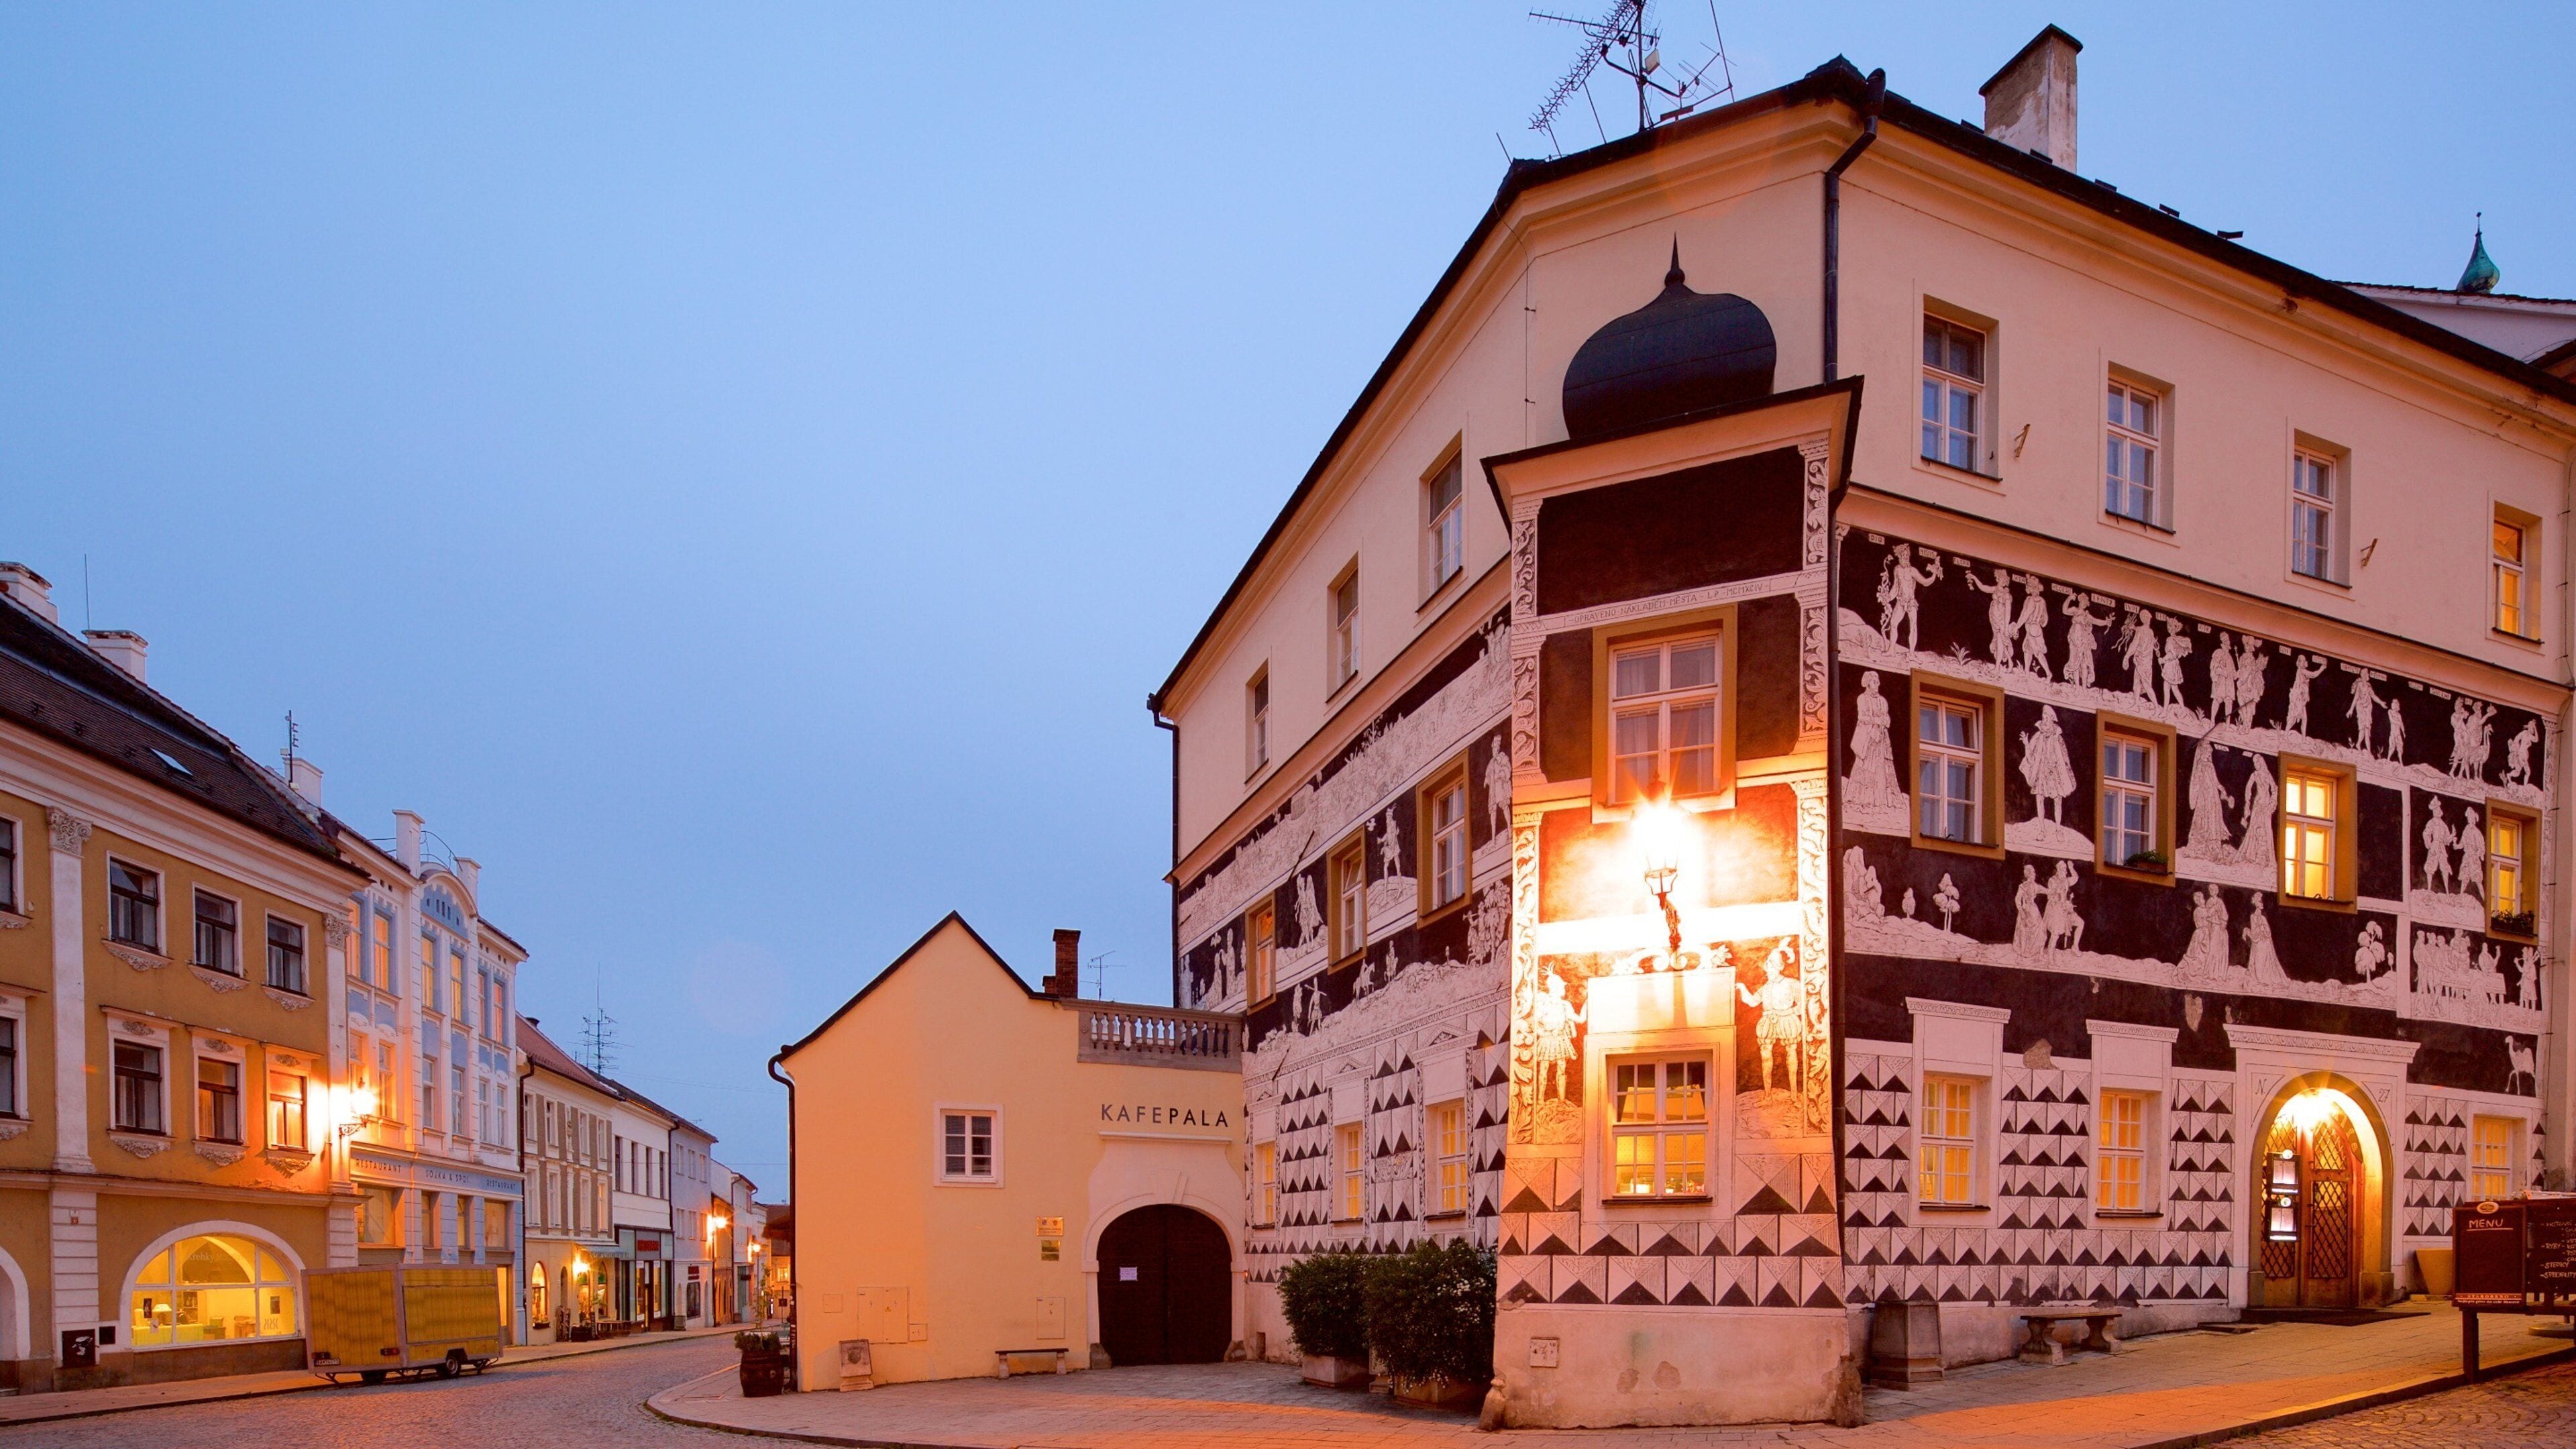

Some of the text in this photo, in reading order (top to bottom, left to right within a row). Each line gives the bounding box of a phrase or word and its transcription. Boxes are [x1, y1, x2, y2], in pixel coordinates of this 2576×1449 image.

[1574, 608, 1616, 623] OPRAVENO
[1727, 583, 1763, 596] MCMXCIV
[2378, 1088, 2391, 1104] 27
[1101, 1104, 1229, 1128] KAFEPALA
[355, 1159, 402, 1173] RESTAURANT
[425, 1169, 446, 1181] SOJKA
[486, 1179, 516, 1190] RESTAURANT
[2469, 1218, 2504, 1228] MENU
